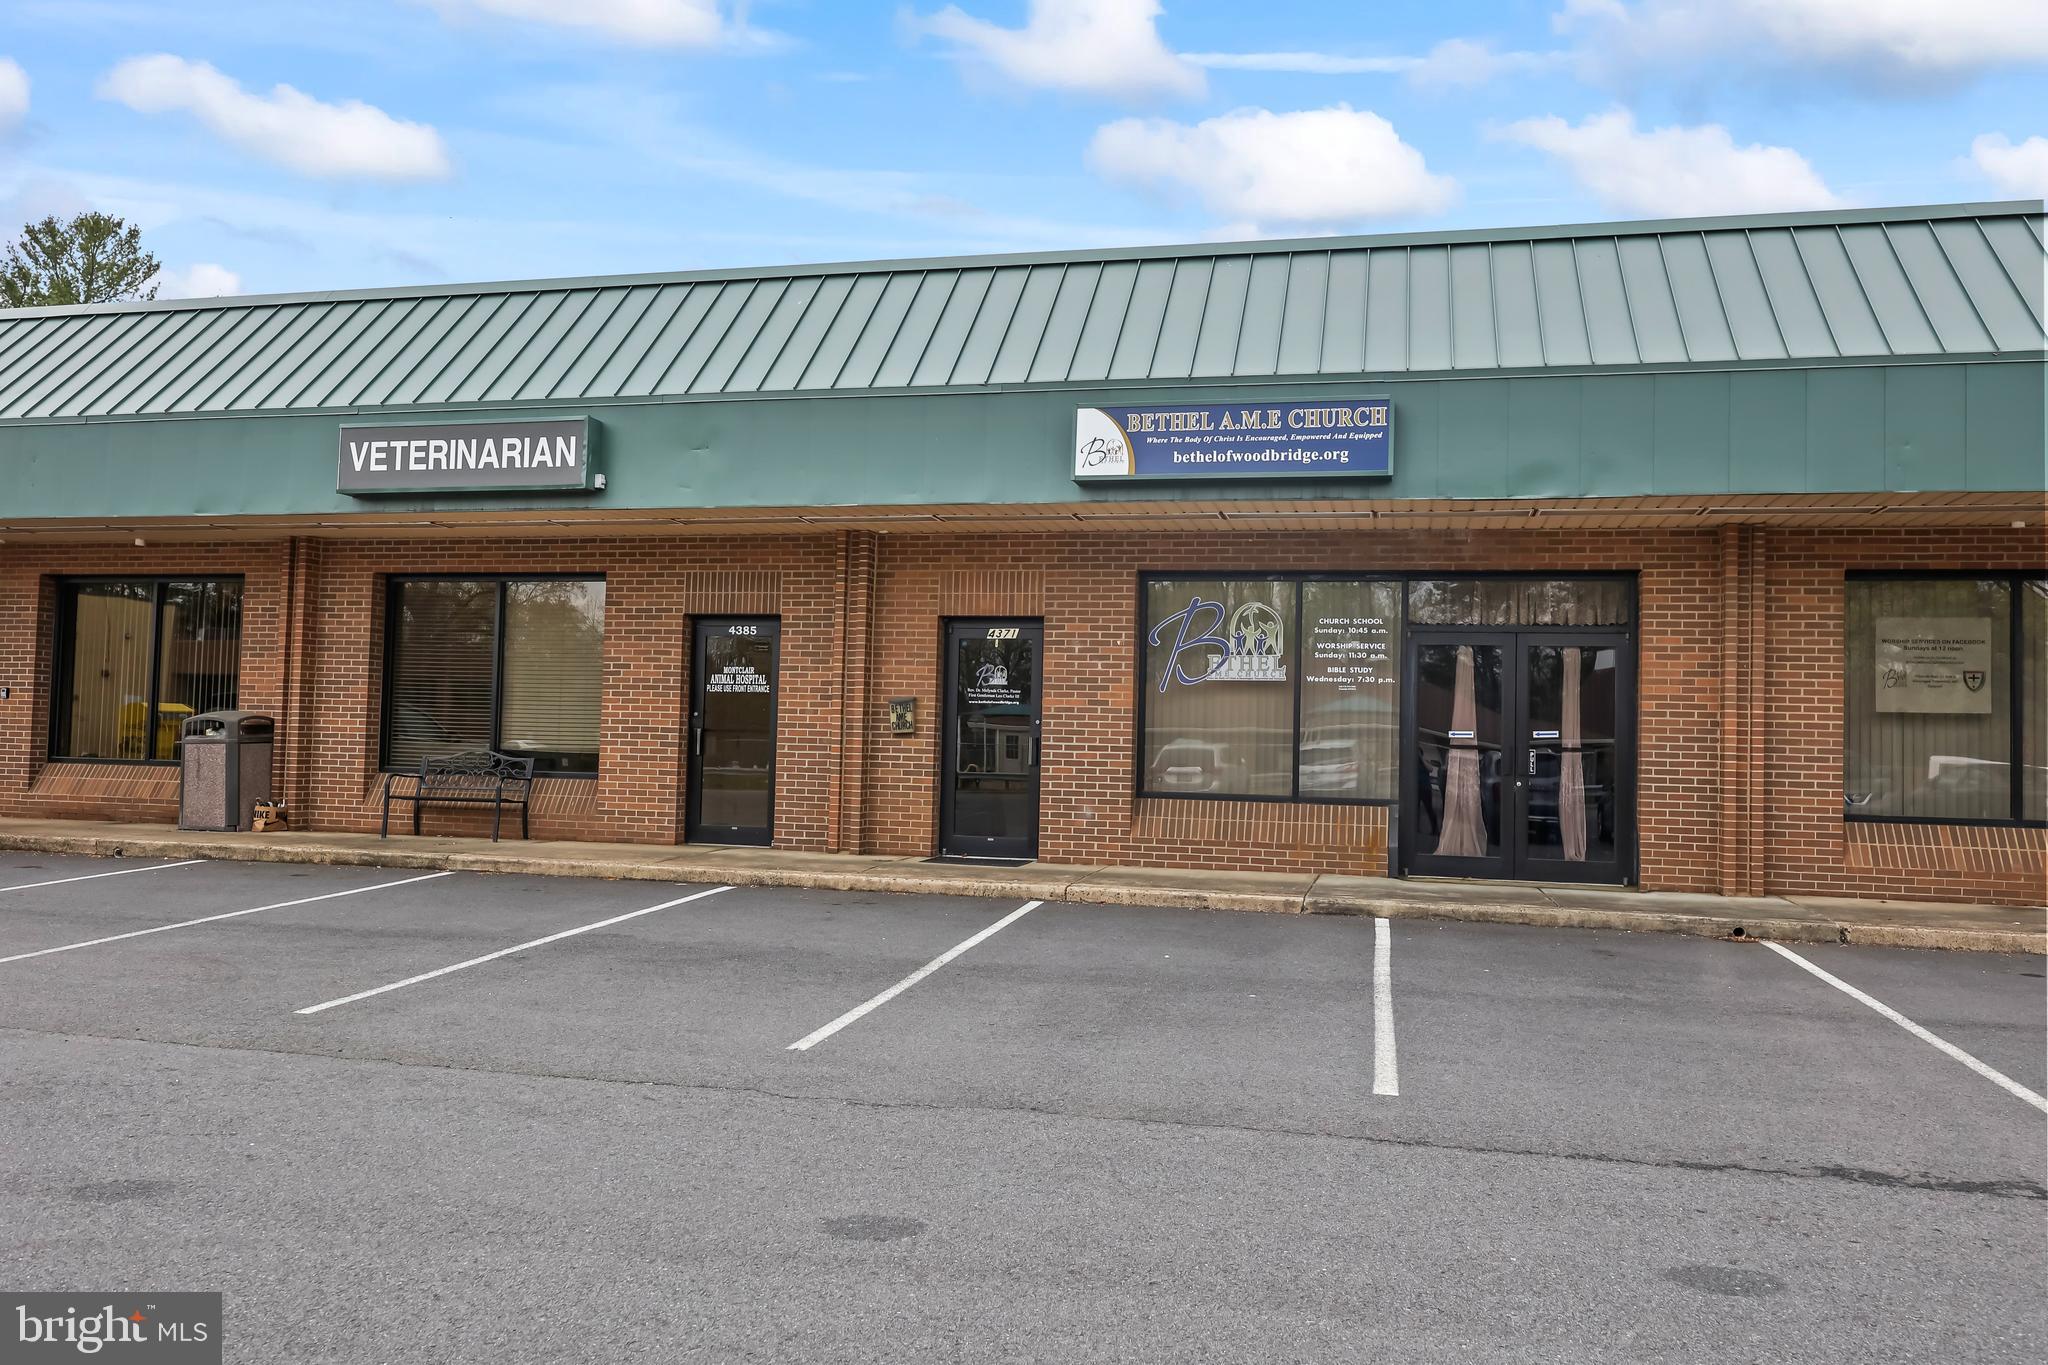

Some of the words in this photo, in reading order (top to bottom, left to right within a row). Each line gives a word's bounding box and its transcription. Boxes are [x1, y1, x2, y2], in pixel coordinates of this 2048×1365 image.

[1127, 412, 1214, 433] BETHEL
[1219, 410, 1281, 431] A.M.E
[1288, 407, 1387, 428] CHURCH
[1184, 436, 1202, 444] Body
[1203, 436, 1213, 444] Of
[1245, 434, 1288, 443] Encouraged,
[1290, 433, 1331, 442] Empowered
[1348, 432, 1383, 440] Equipped
[350, 436, 576, 471] VETERINARIAN
[1173, 448, 1349, 464] bethelofwoodbridge.org
[728, 626, 757, 635] 4385
[988, 629, 1016, 638] 4371
[1314, 626, 1345, 634] Sunday:
[710, 674, 734, 684] ANIMAL
[736, 674, 766, 684] HOSPITAL
[1306, 676, 1354, 684] Wednesday:
